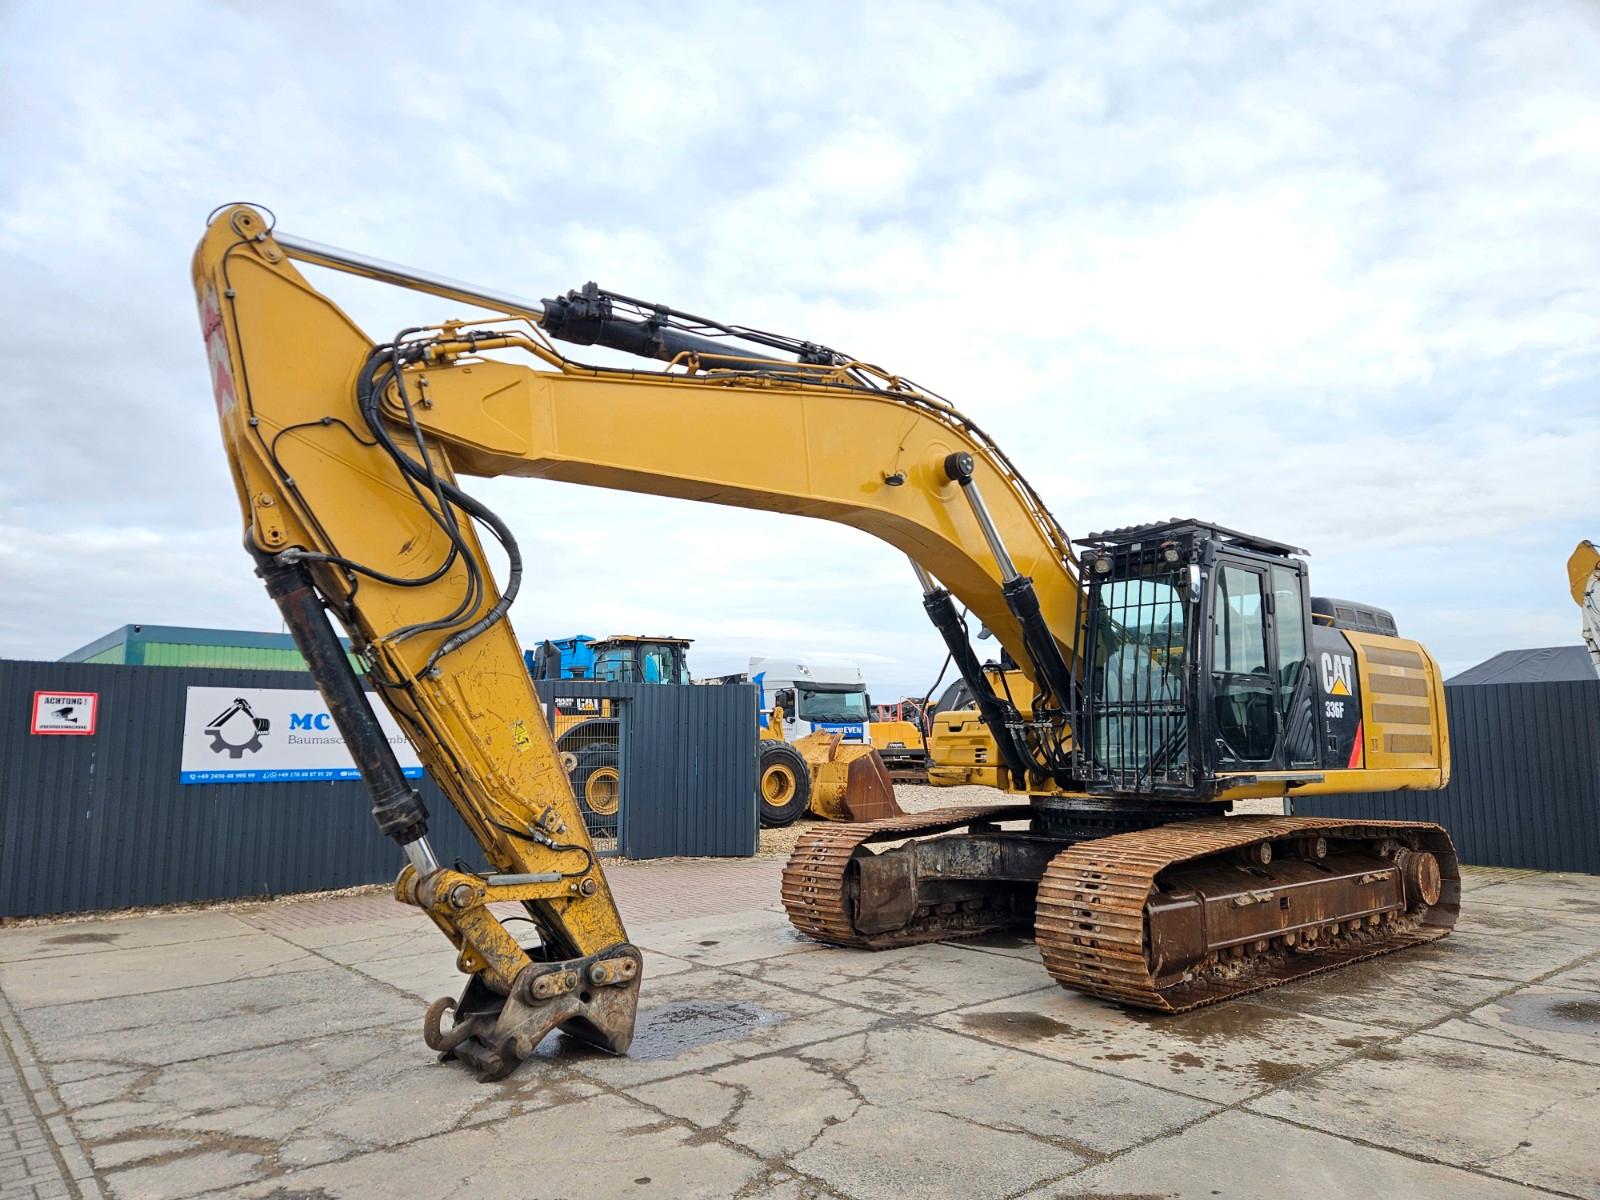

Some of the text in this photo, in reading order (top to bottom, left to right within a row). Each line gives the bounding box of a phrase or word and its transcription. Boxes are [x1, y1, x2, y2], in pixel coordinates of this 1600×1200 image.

[1321, 652, 1352, 696] CAT
[44, 697, 82, 705] ACHTUNG
[1325, 701, 1344, 718] 336F
[289, 713, 330, 731] MC
